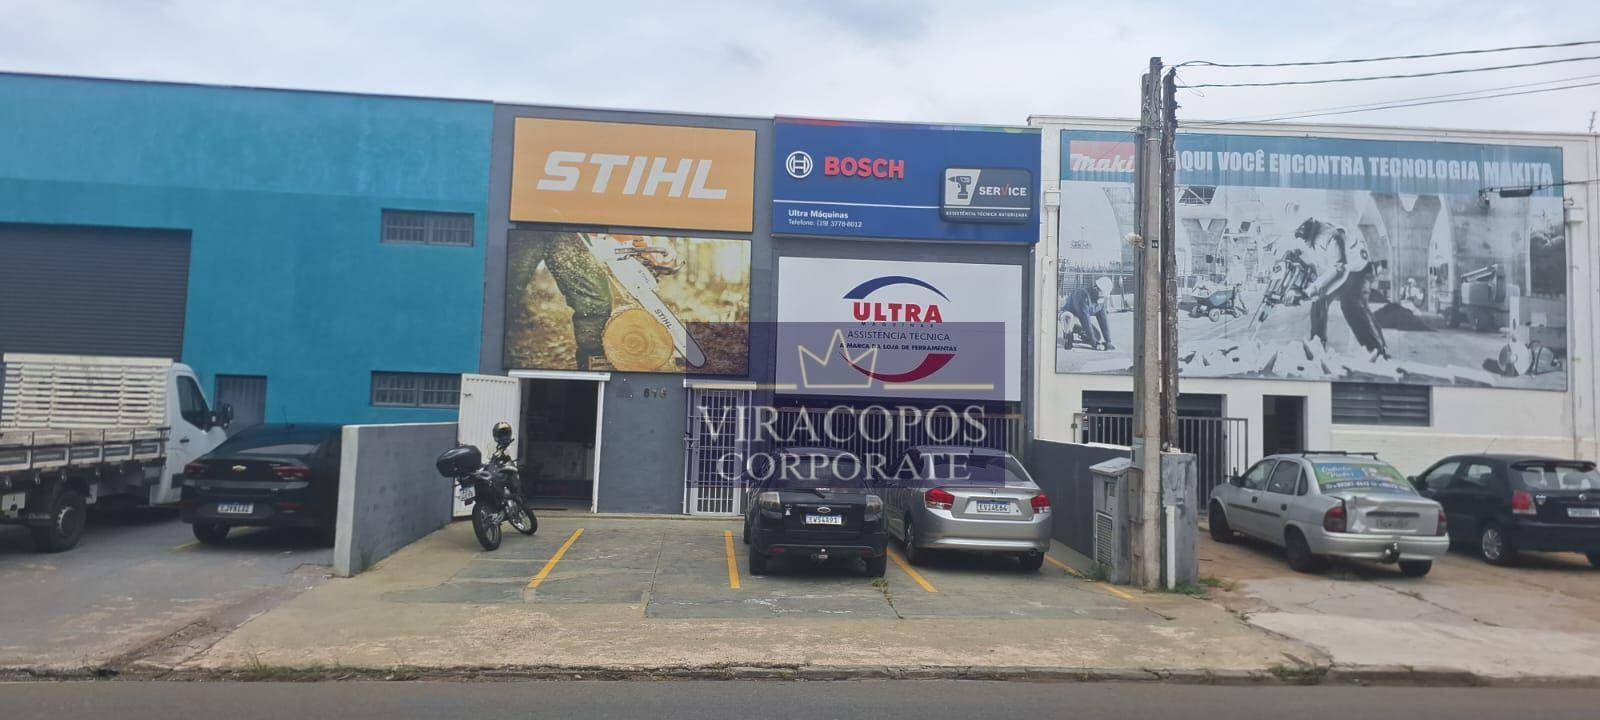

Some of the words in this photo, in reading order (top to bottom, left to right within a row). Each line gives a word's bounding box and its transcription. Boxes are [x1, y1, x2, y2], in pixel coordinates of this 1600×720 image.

[825, 156, 905, 179] BOSCH
[1070, 153, 1135, 173] Maki
[1175, 150, 1213, 171] AQUI
[1217, 149, 1265, 173] VOCÊ
[1269, 153, 1365, 176] ENCONTRA
[1368, 157, 1480, 182] TECNOLOGIA
[1483, 161, 1554, 187] MAKITA
[536, 151, 728, 200] STIHL
[979, 184, 1028, 197] SERVICE
[788, 209, 809, 217] Ultra
[810, 210, 849, 219] Máquinas
[788, 218, 815, 226] Telefone:
[654, 309, 673, 330] STIHL
[853, 302, 943, 323] ULTRA
